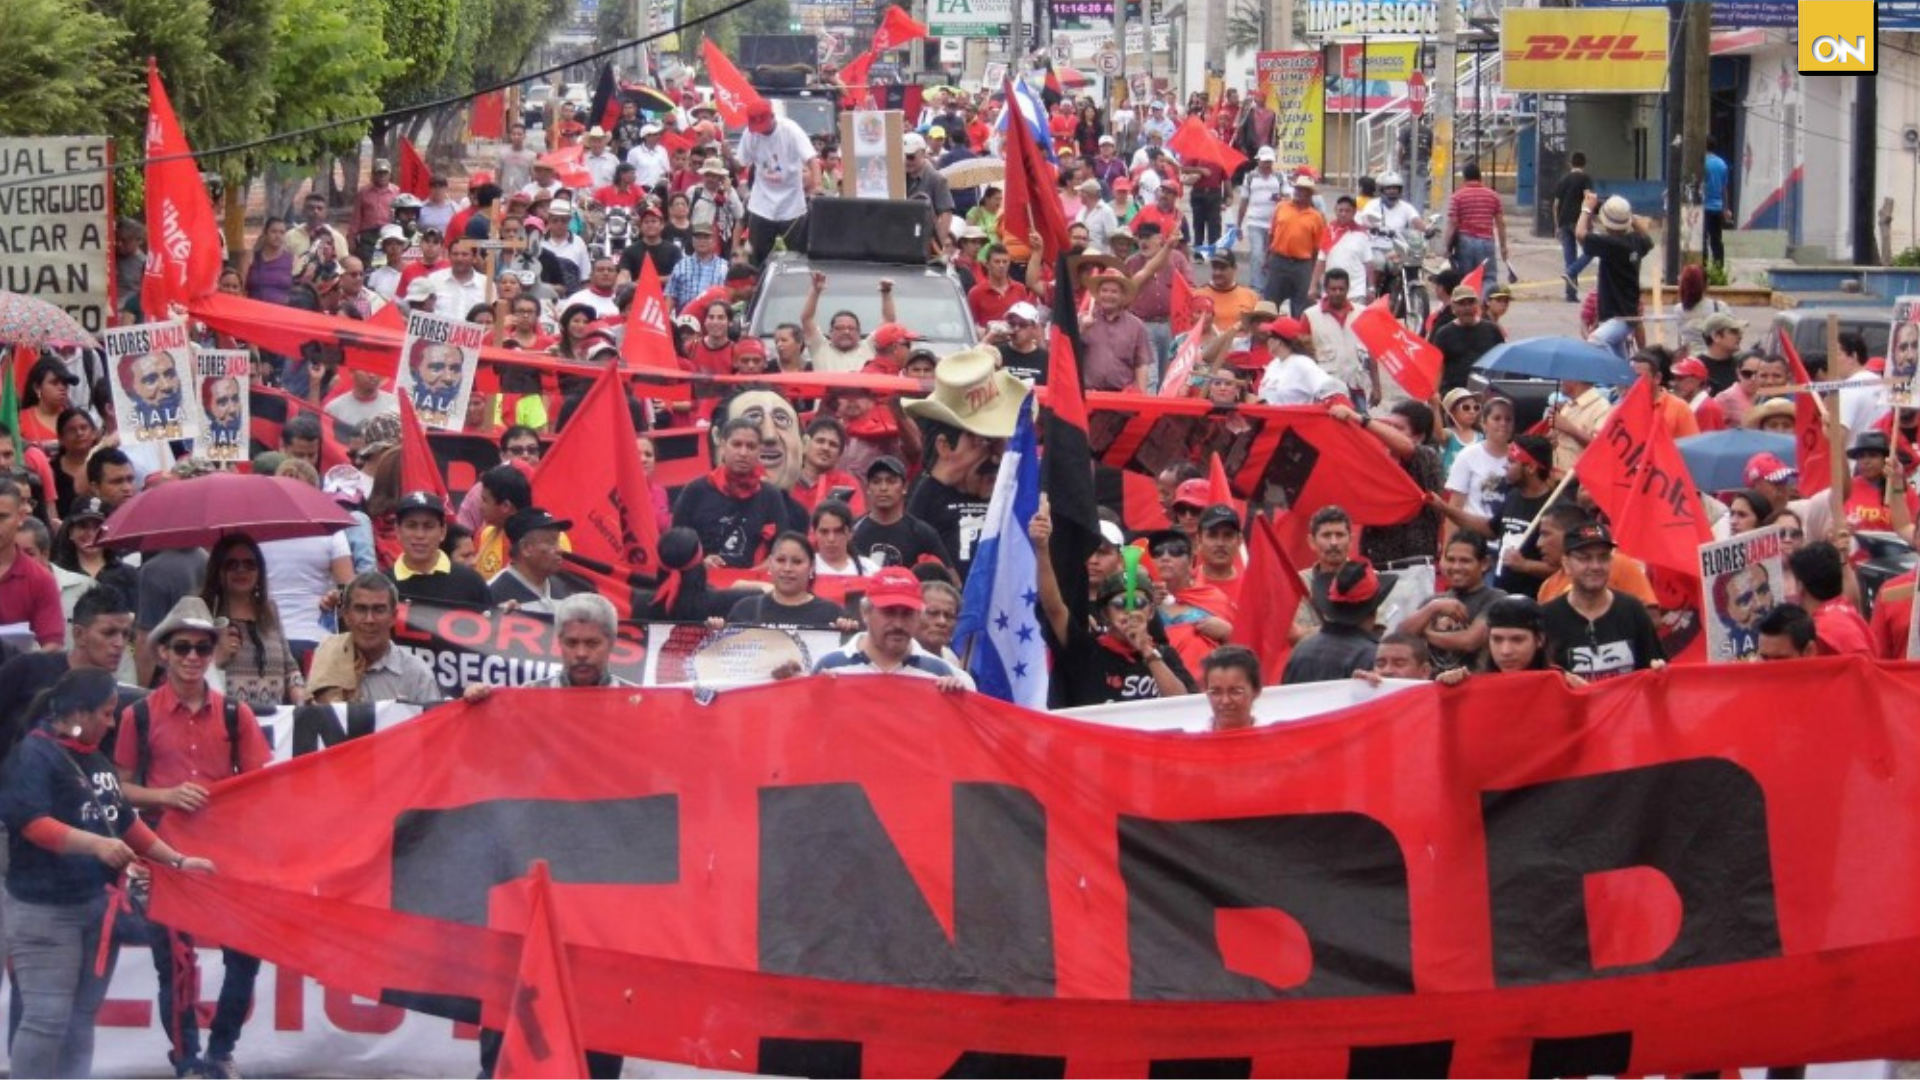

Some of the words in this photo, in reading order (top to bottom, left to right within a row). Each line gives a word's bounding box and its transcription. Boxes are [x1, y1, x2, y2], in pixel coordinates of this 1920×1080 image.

[1524, 34, 1645, 61] DHL
[106, 329, 149, 356] FLORES
[150, 325, 186, 351] LANZA
[406, 314, 449, 343] FLORES
[448, 322, 482, 350] LANZA
[197, 354, 226, 376] FLORES
[227, 354, 248, 377] LANZA
[1702, 542, 1746, 577] FLORES
[1746, 532, 1780, 565] LANZA
[395, 601, 646, 665] LORS
